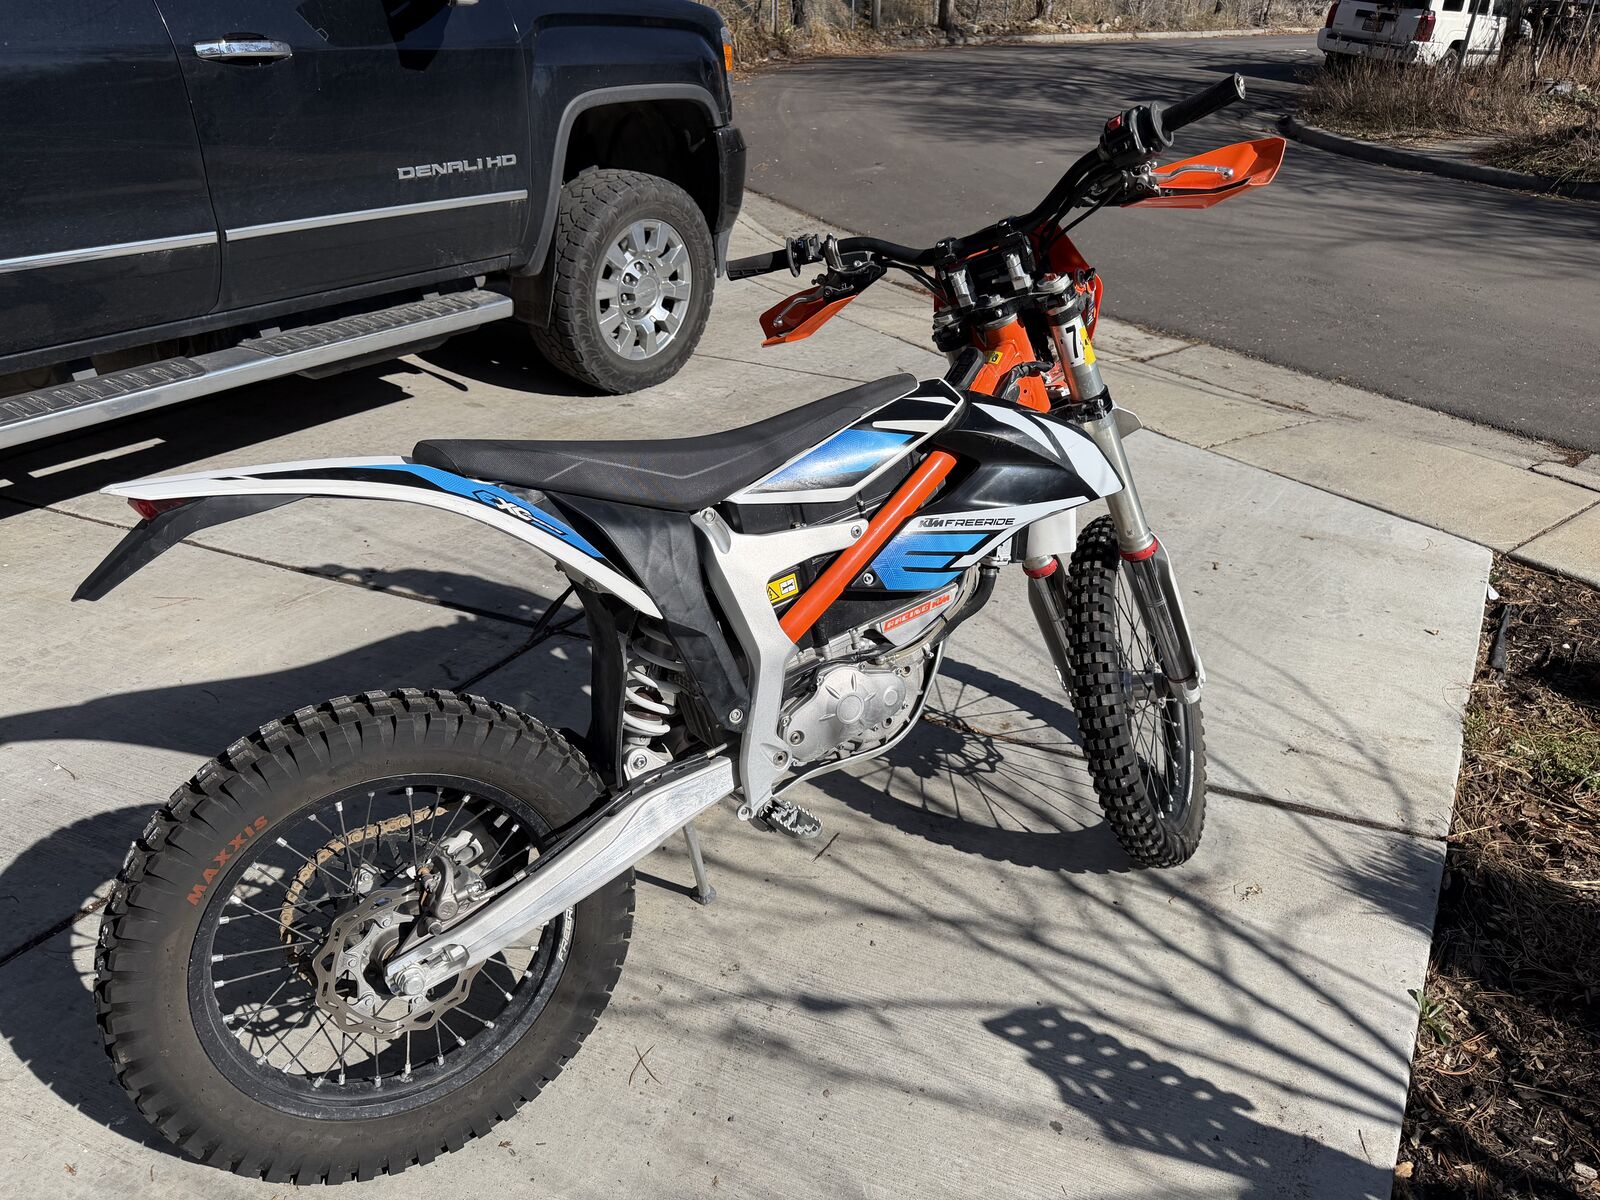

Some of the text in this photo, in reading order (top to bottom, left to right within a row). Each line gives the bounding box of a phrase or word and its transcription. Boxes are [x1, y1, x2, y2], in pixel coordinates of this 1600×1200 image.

[397, 154, 517, 180] DENALI HD
[1065, 325, 1079, 359] 7
[918, 517, 1016, 528] KTM FREERIDE
[186, 815, 268, 906] MAXXIS
[557, 906, 575, 963] FREERI
